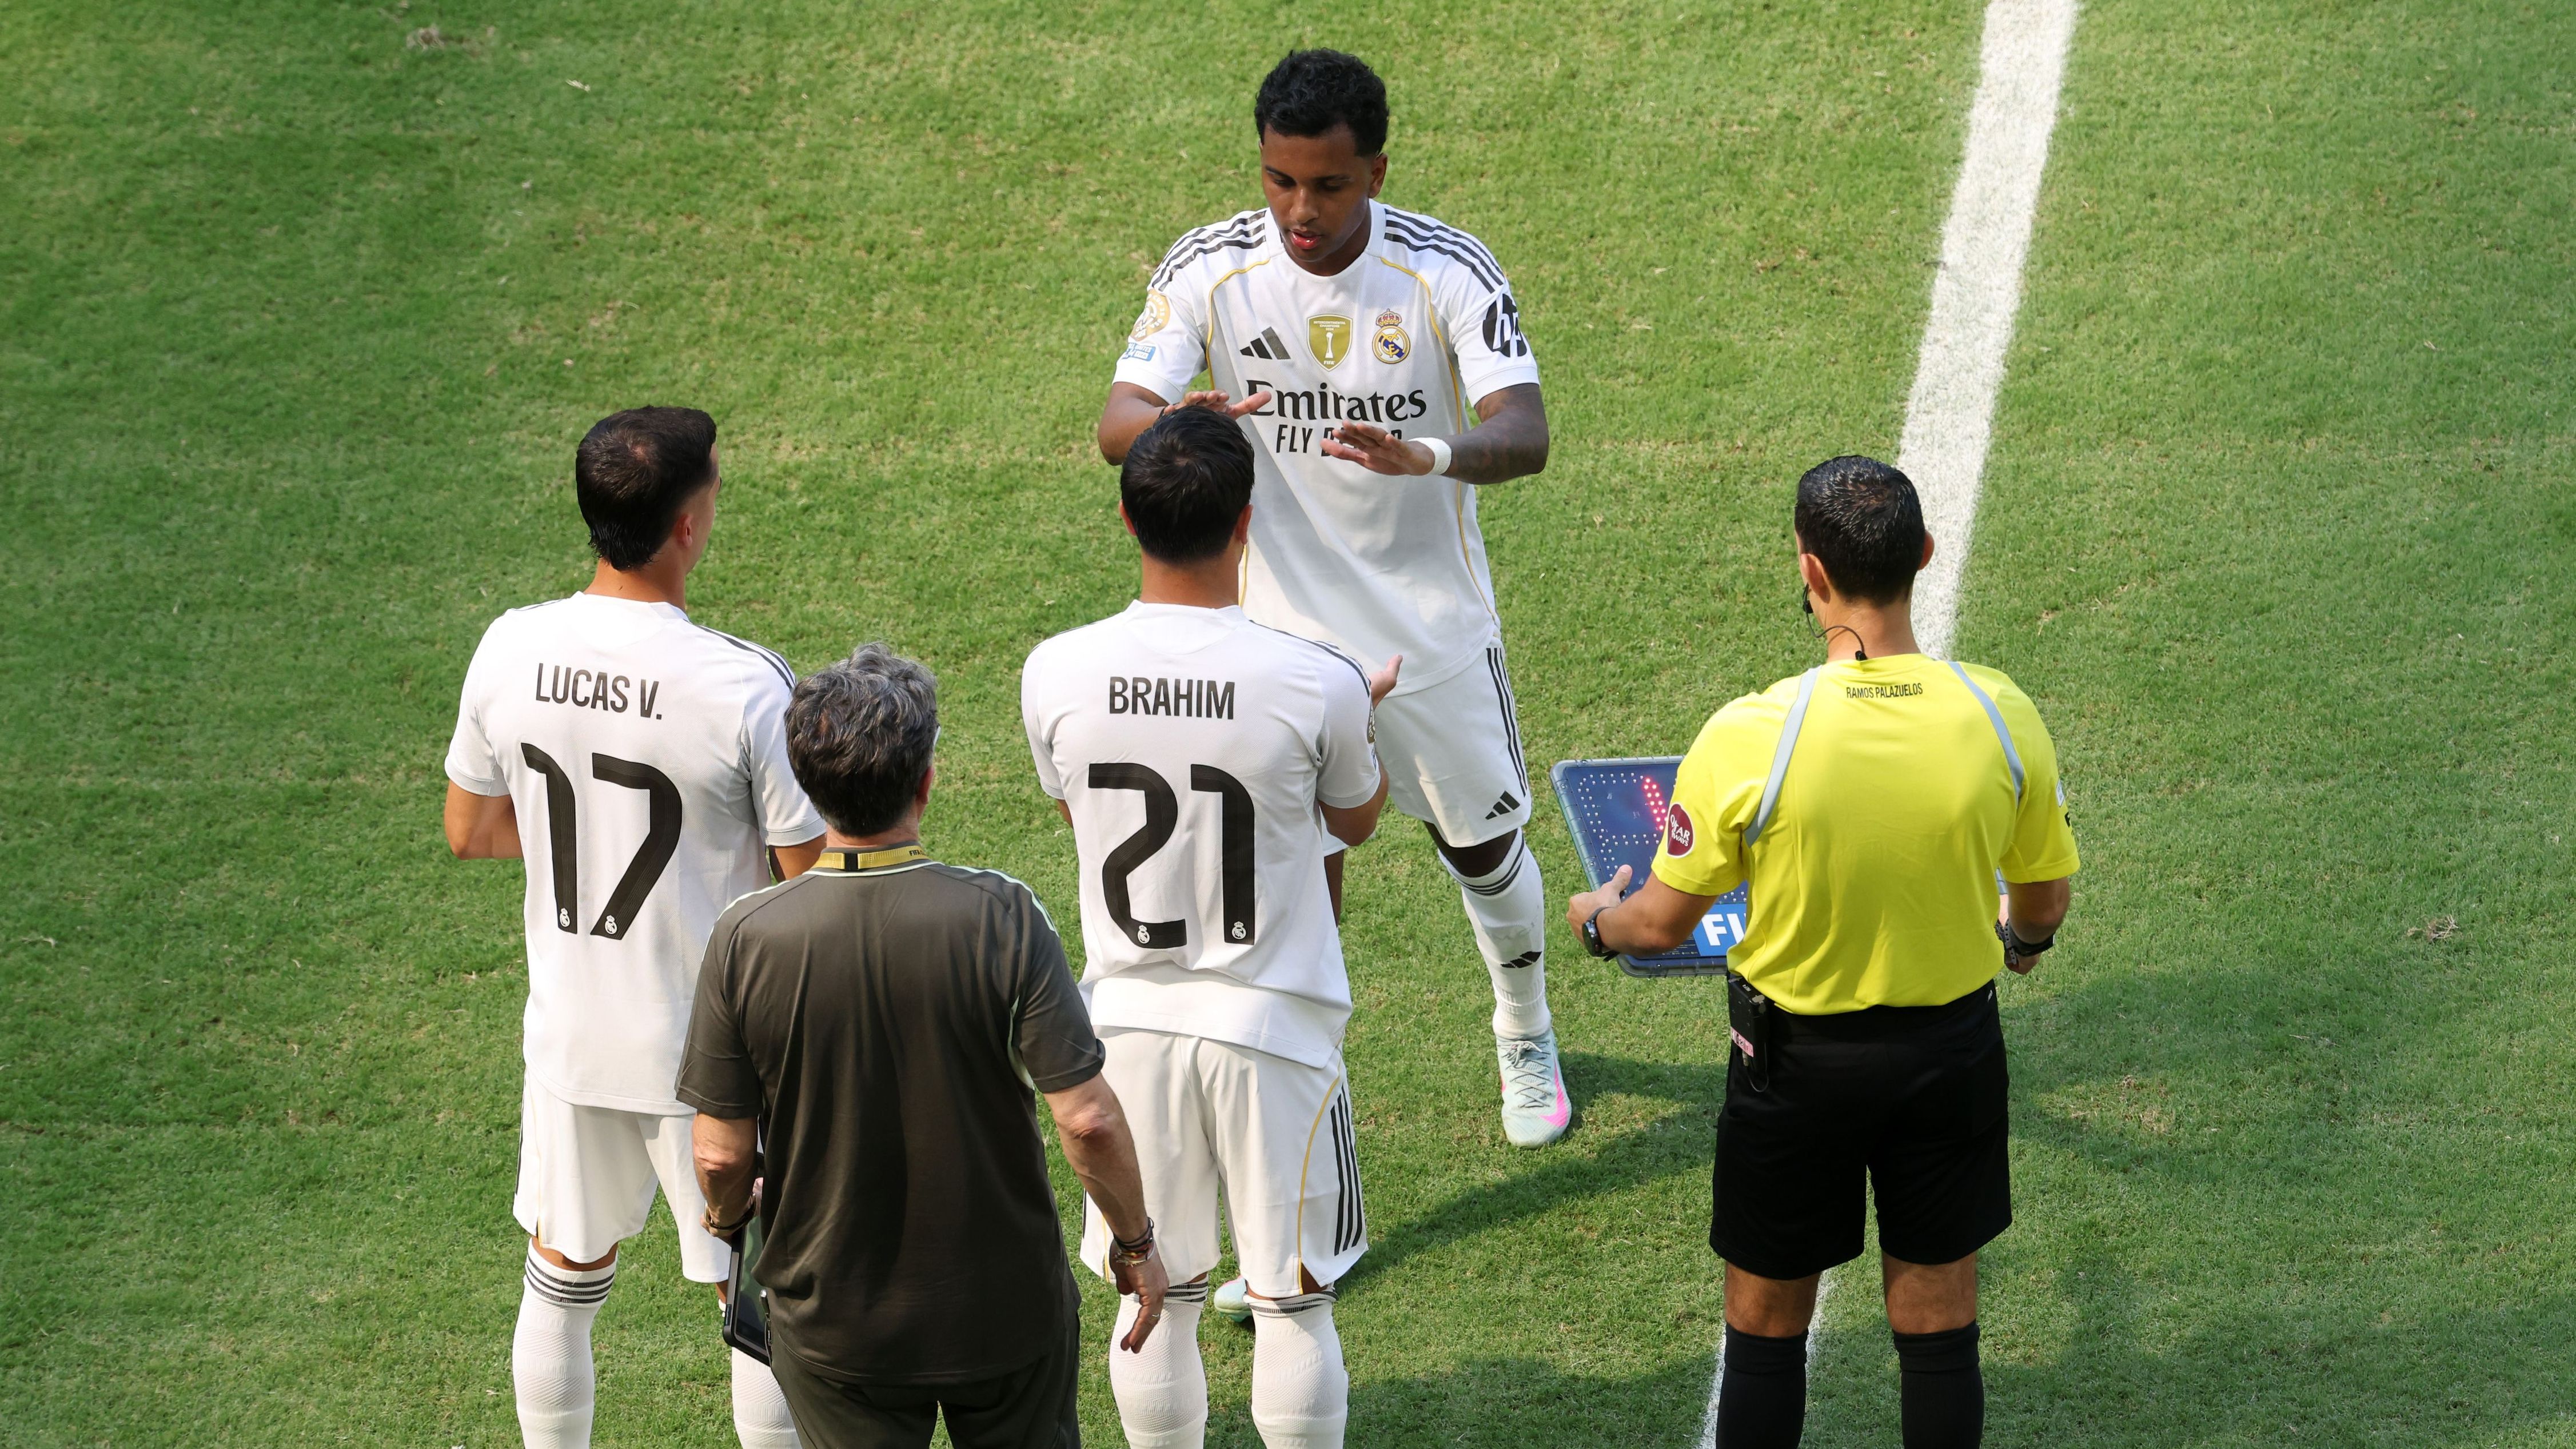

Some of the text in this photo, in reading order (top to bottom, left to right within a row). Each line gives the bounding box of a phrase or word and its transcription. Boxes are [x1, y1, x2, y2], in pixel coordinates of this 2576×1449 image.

[1246, 380, 1427, 422] Emirates
[1276, 424, 1313, 453] FLY
[536, 663, 662, 720] LUCAS V.
[1109, 676, 1235, 720] BRAHIM
[1846, 682, 1923, 698] RAMOS PALAZUELOS
[521, 743, 683, 940] 17
[1670, 815, 1690, 841] QATAR
[1088, 763, 1255, 949] 21
[1701, 913, 1746, 946] FI
